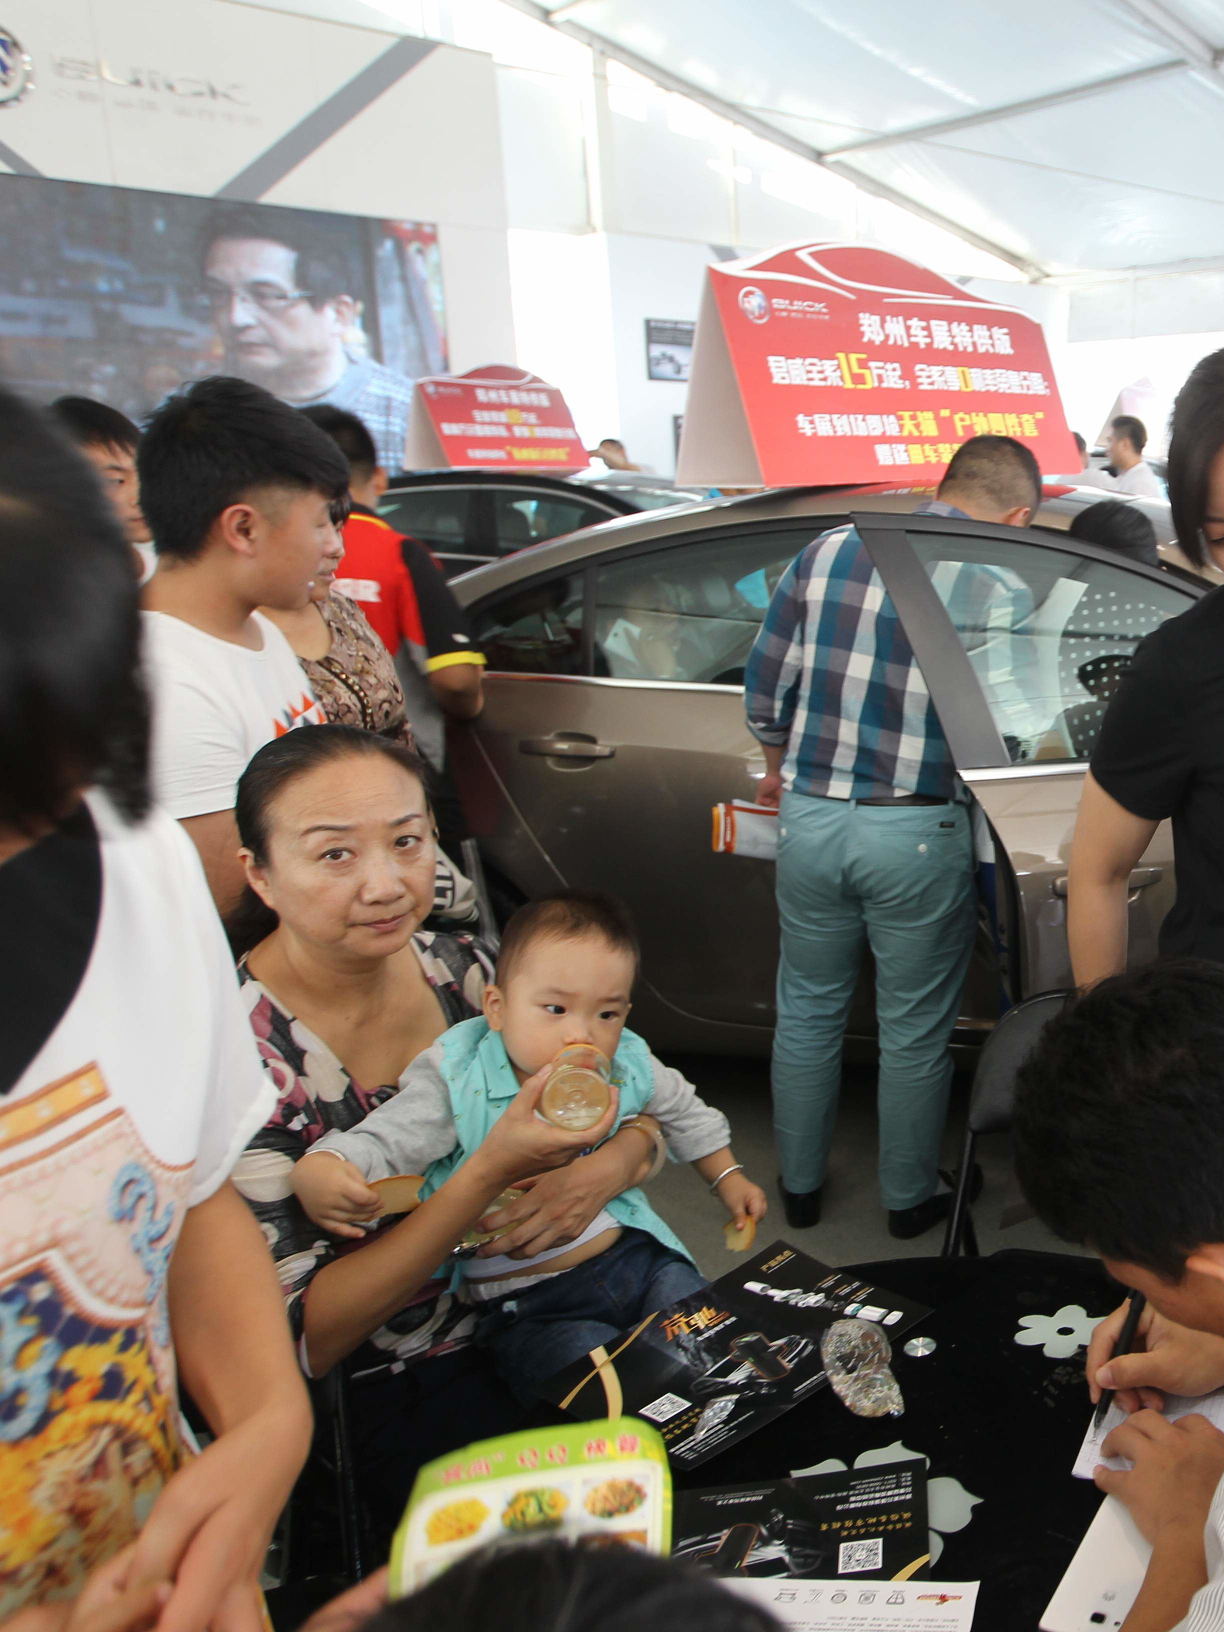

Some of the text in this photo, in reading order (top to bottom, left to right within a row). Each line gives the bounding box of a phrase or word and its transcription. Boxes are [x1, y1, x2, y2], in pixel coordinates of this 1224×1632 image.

[771, 298, 830, 312] BUICK
[858, 312, 1014, 355] 郑州车展特供版
